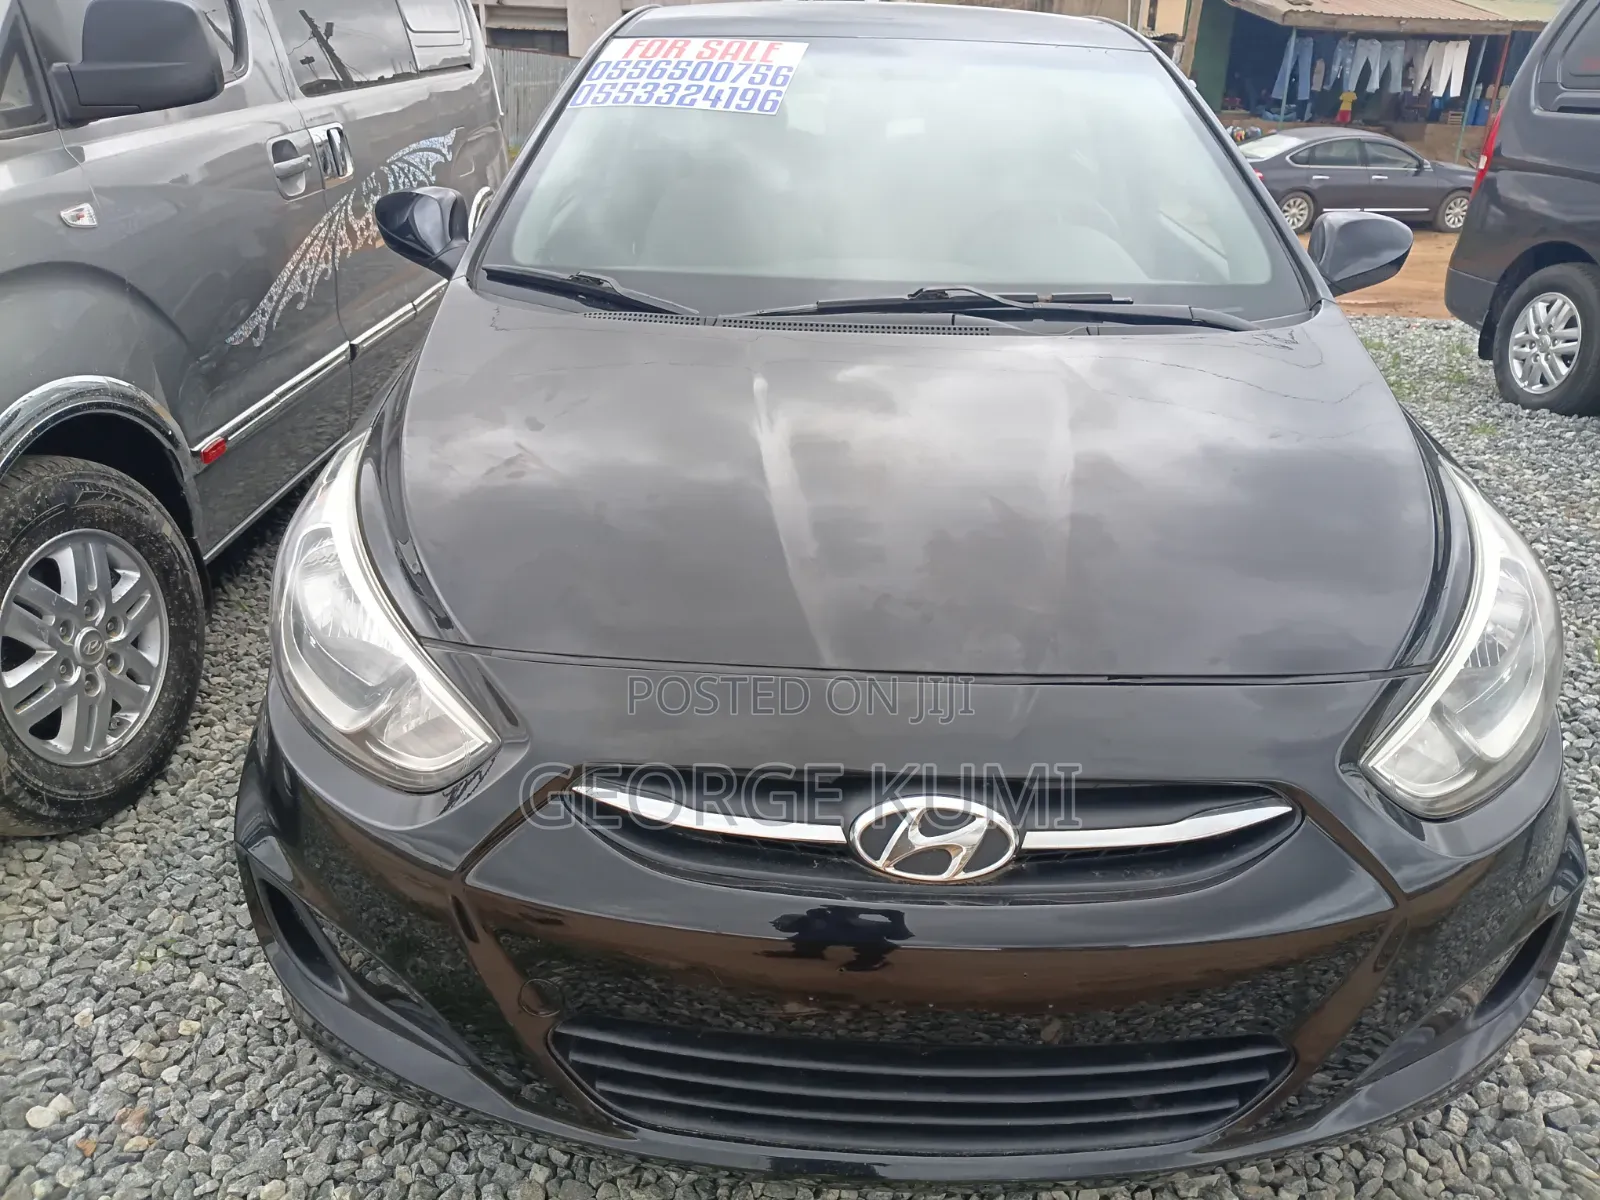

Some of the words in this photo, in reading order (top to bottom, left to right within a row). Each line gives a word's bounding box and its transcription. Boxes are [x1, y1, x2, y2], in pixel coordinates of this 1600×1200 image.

[622, 39, 691, 60] FOR
[696, 39, 783, 63] SALE
[585, 60, 794, 87] 0556500756
[569, 82, 783, 113] 0553324196
